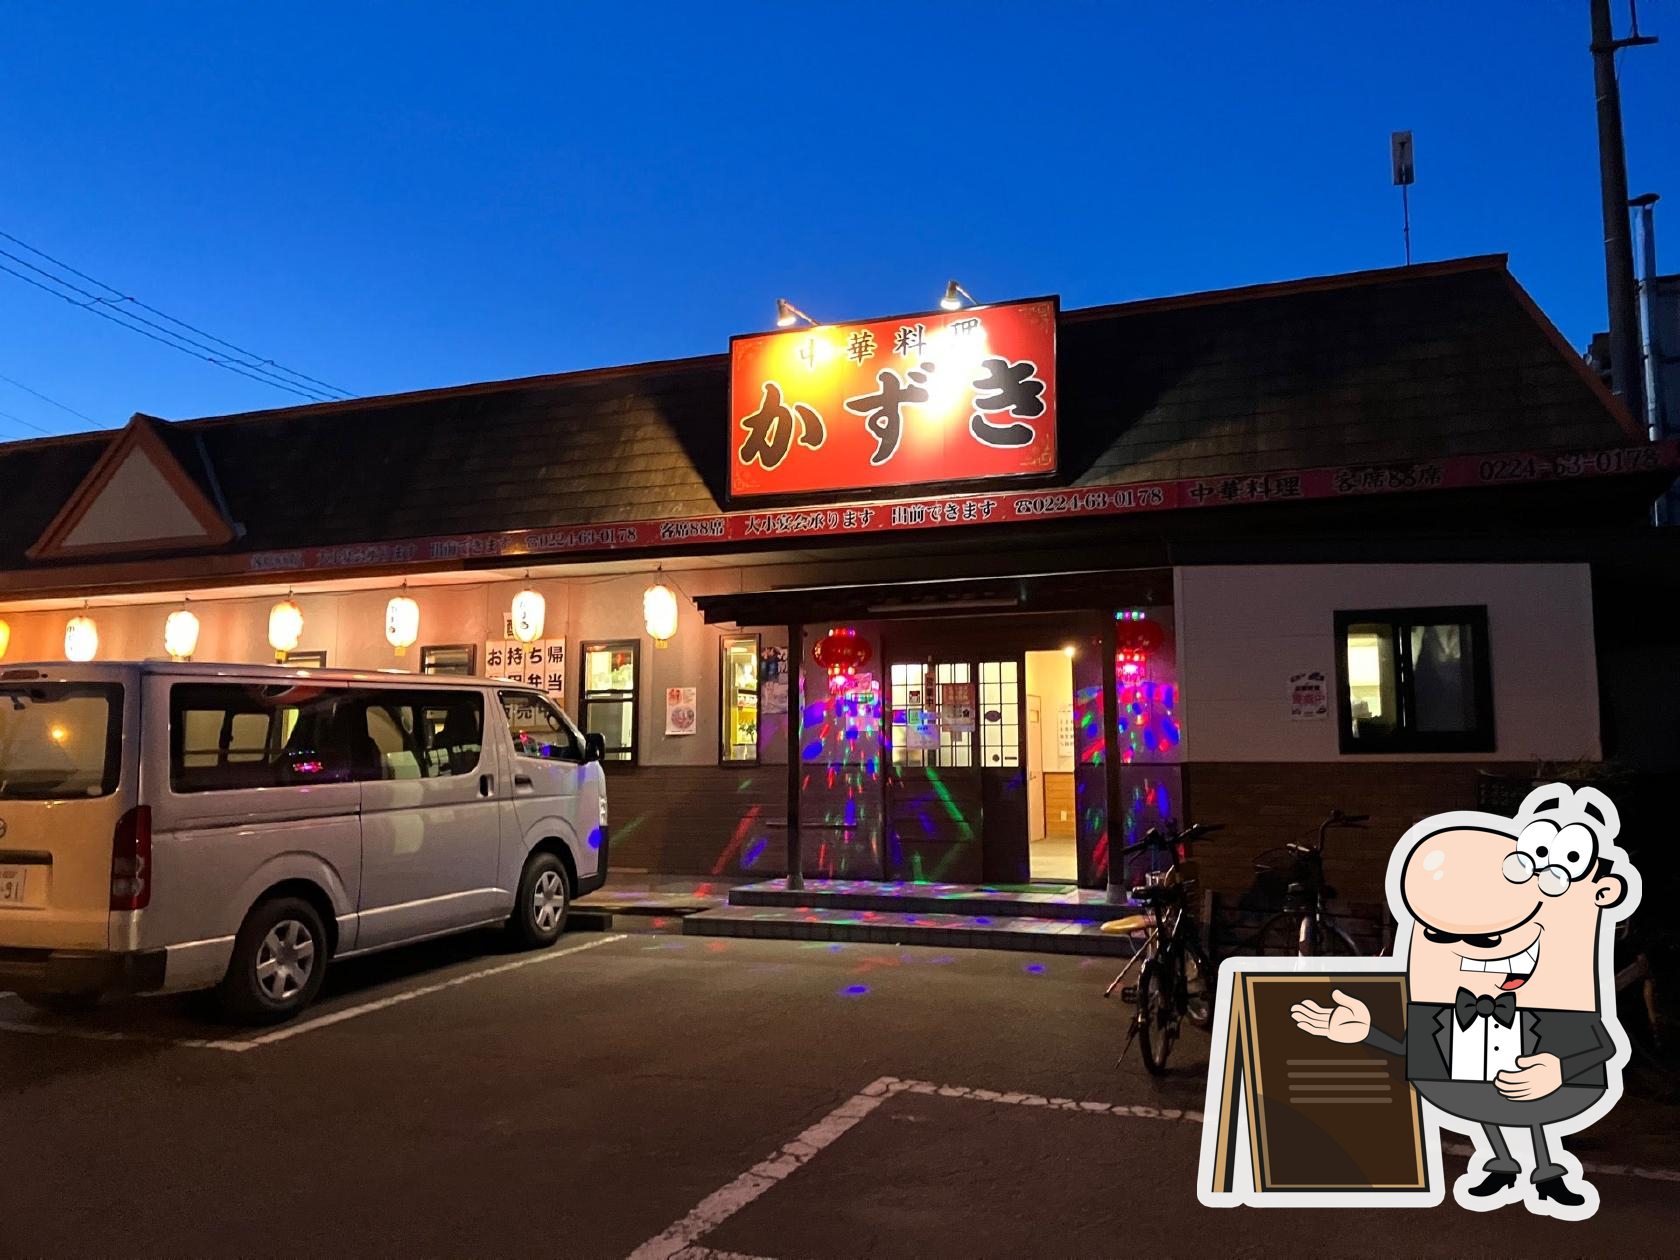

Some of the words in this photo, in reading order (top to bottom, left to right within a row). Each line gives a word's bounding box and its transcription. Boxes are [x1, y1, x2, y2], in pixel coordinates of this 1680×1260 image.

[740, 358, 1047, 471] かずき
[744, 508, 875, 535] 大小宴会承ります
[891, 500, 996, 525] 出前できます
[1190, 475, 1303, 501] 中華料理
[487, 646, 563, 666] お持ち帰
